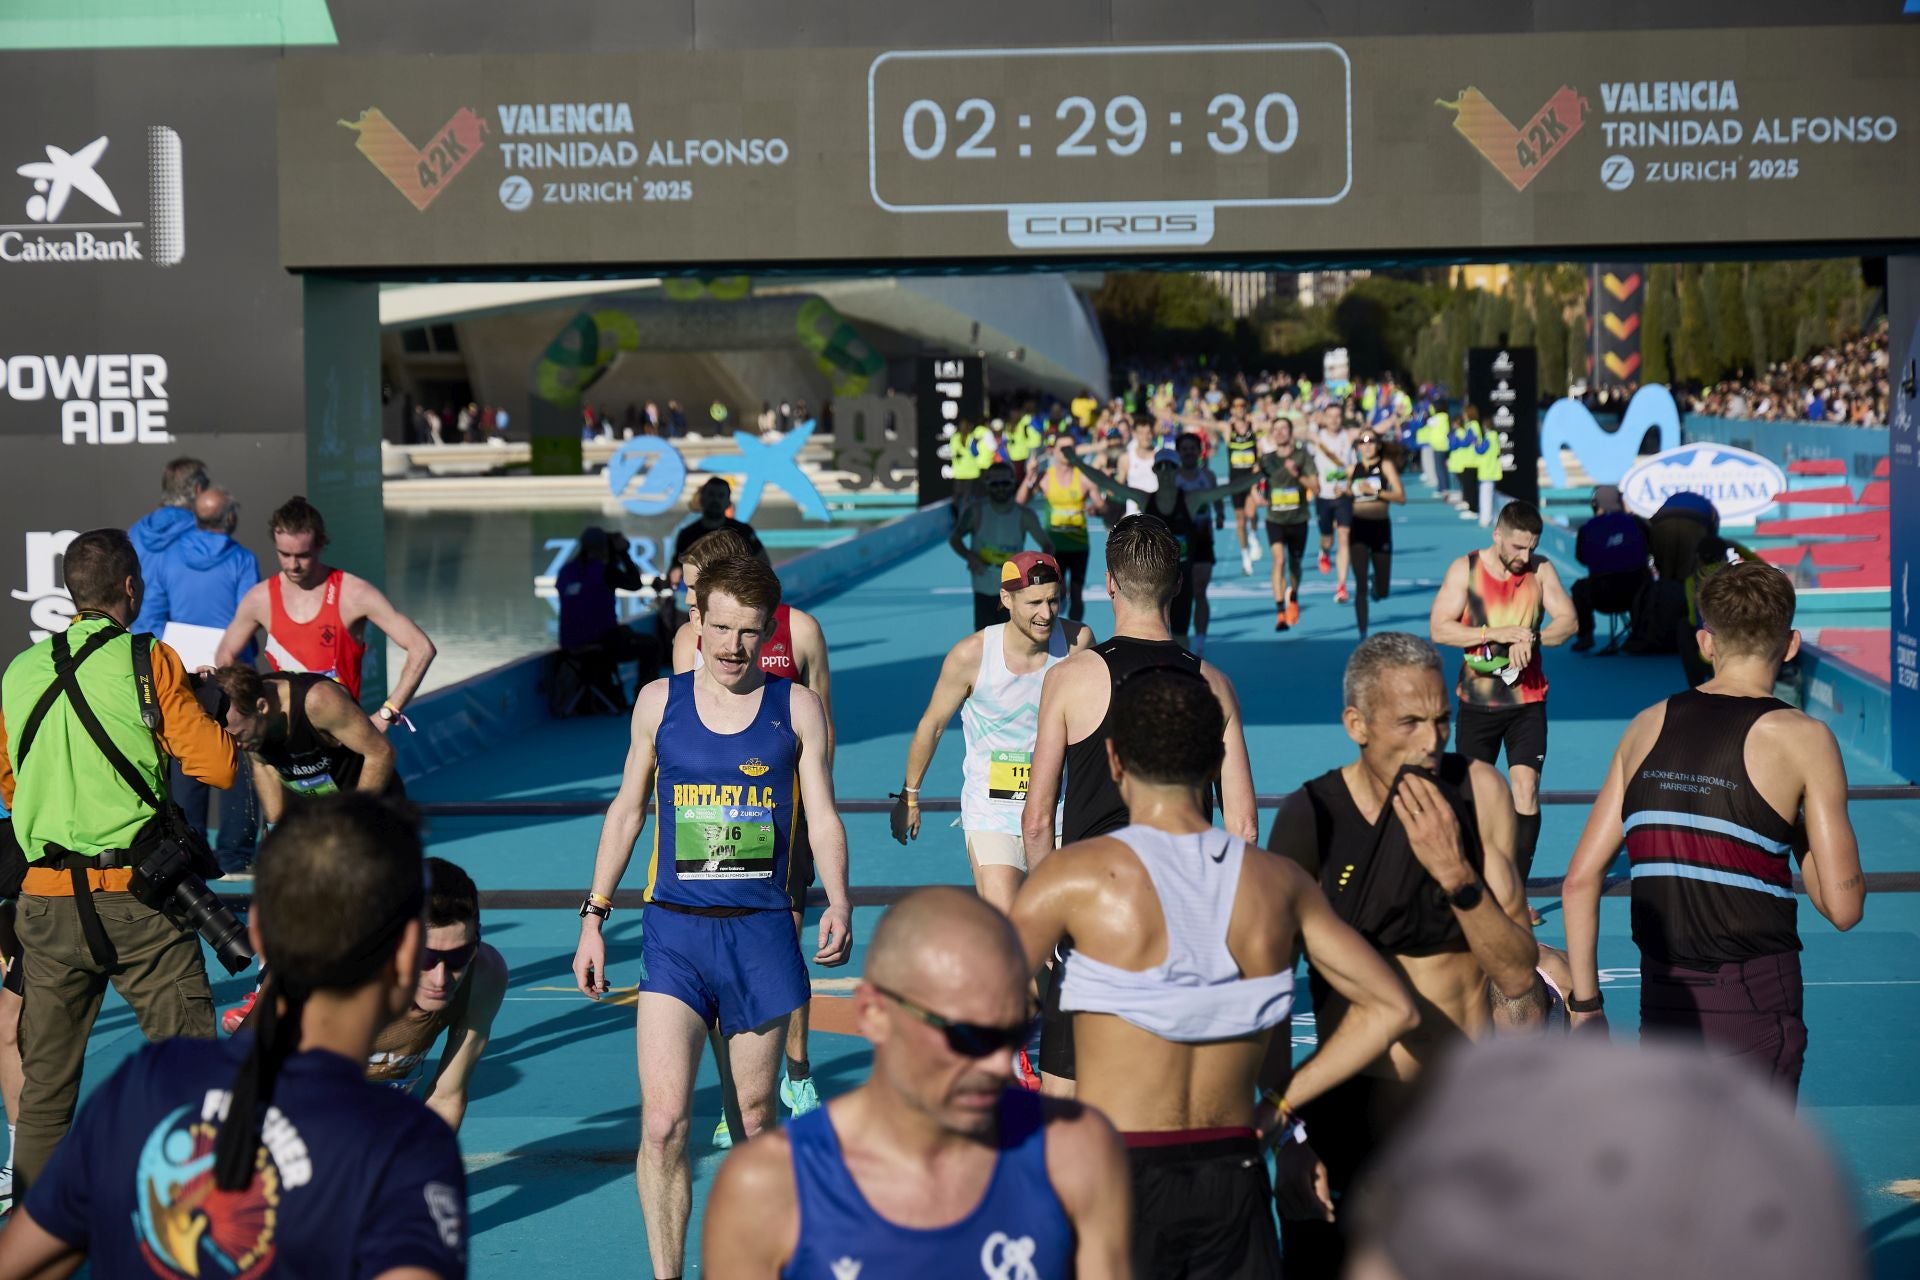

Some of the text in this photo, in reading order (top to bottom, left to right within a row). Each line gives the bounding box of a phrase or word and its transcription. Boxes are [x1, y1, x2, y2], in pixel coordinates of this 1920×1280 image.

[1600, 80, 1739, 113] VALENCIA
[498, 103, 634, 135] VALENCIA
[1601, 115, 1898, 147] TRINIDAD ALFONSO
[1516, 107, 1569, 169] 42K
[418, 128, 468, 189] 42K
[500, 138, 790, 169] TRINIDAD ALFONSO
[1645, 160, 1737, 182] ZURICH
[1748, 158, 1800, 180] 2025
[543, 182, 633, 203] ZURICH
[643, 181, 694, 201] 2025
[1025, 214, 1198, 236] COROS
[0, 230, 144, 263] CaixaBank
[0, 353, 169, 401] OWER
[1639, 477, 1770, 501] ASRIANA
[761, 656, 790, 668] PPTC
[143, 684, 152, 704] Nikon
[1011, 766, 1031, 778] 111
[1642, 770, 1690, 781] BLACKHEATH
[1697, 775, 1739, 791] BROMLEY
[673, 784, 777, 809] BIRTLEY A.C.
[1660, 782, 1711, 795] HARRIERS AC
